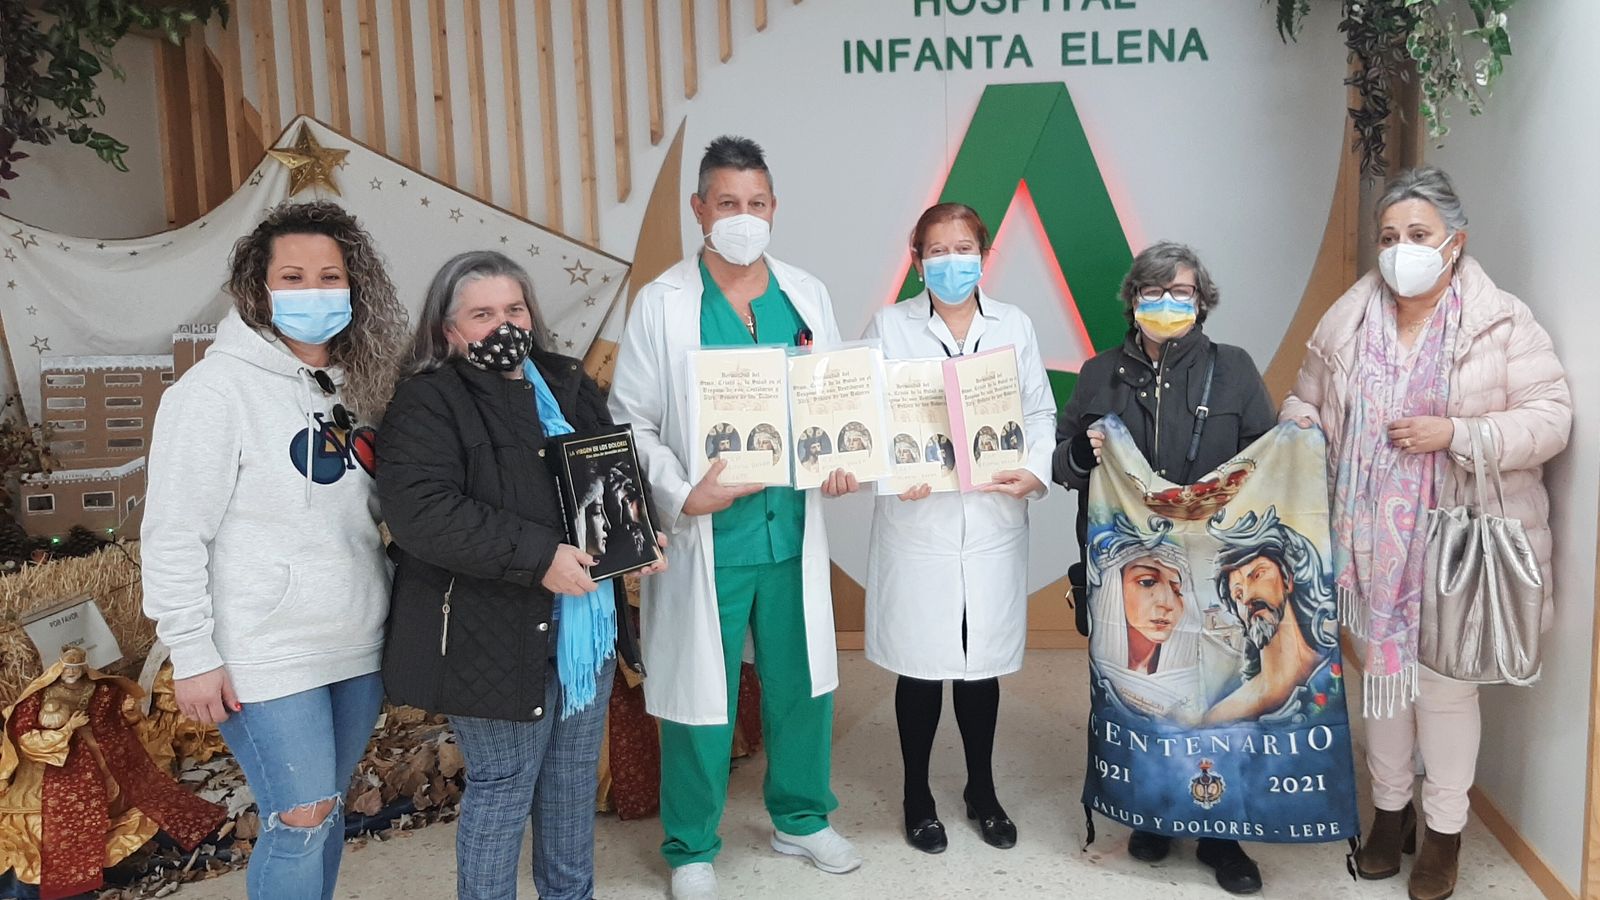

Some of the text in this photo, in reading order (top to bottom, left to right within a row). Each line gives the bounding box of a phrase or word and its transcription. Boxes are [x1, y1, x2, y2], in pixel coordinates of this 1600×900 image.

[844, 27, 1209, 74] INFANTA ELENA
[192, 323, 217, 334] HOS
[49, 612, 80, 628] POR FAVOR
[1091, 713, 1333, 757] CENTENARIO
[1094, 755, 1131, 783] 1921
[1268, 774, 1327, 794] 2021
[1093, 796, 1144, 826] SALUD
[1153, 817, 1164, 830] Y
[1173, 820, 1265, 837] DOLORES
[1289, 821, 1341, 838] LEPE
